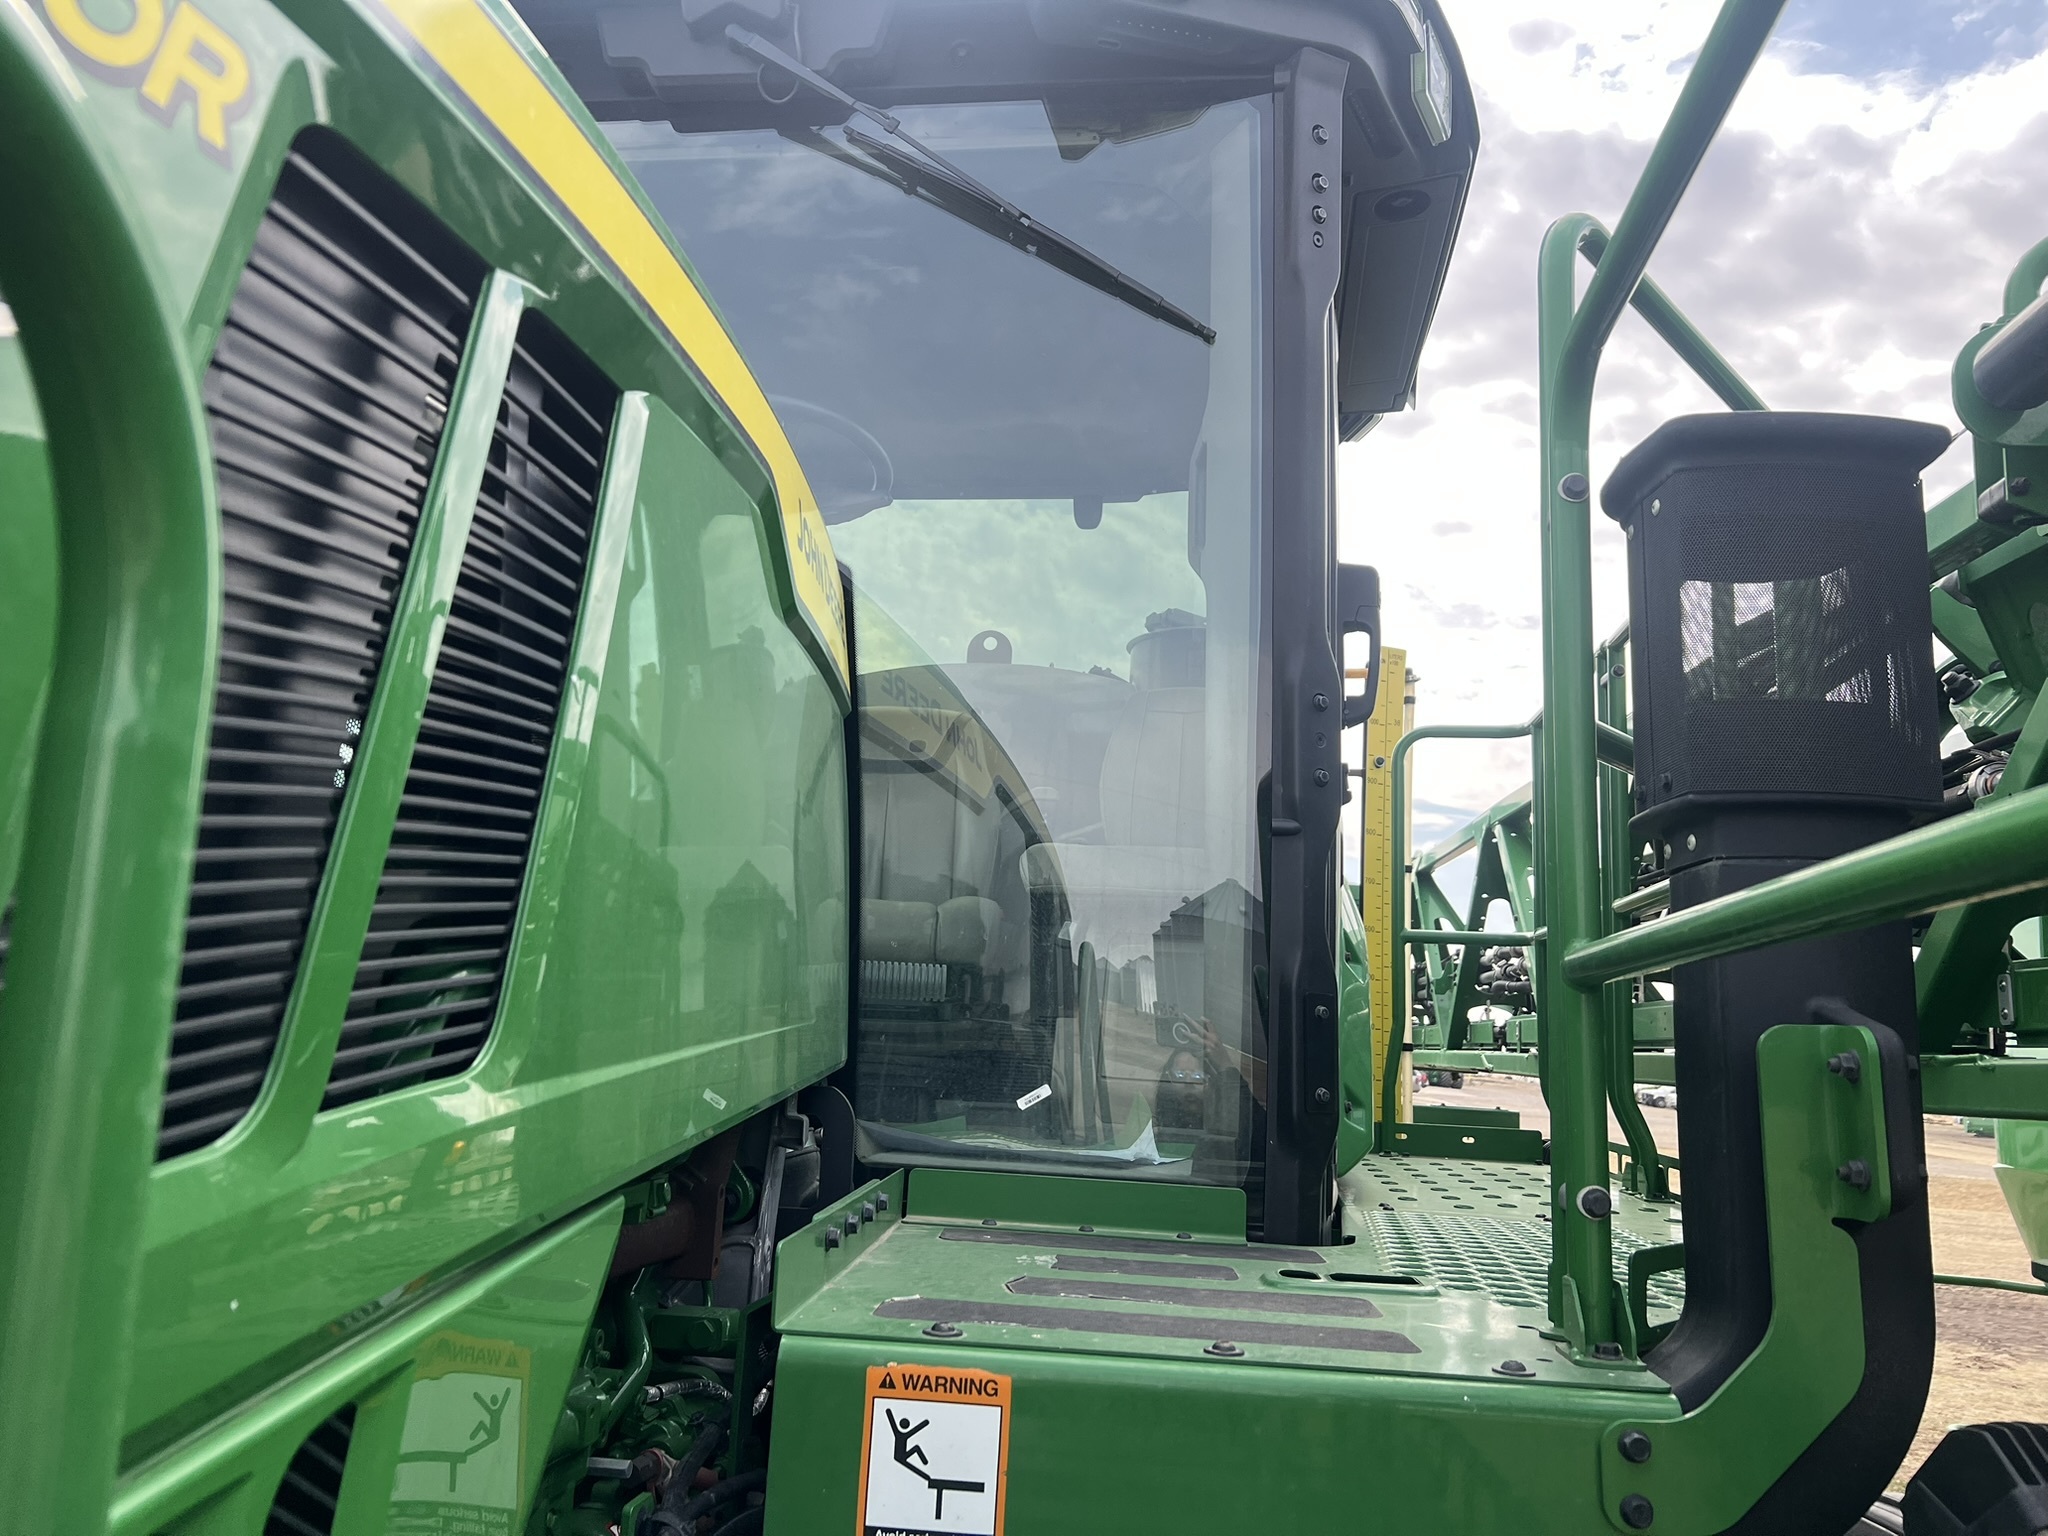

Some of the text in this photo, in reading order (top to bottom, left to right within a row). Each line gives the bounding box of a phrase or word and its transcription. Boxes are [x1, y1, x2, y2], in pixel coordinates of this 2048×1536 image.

[797, 497, 825, 593] JOHN
[1365, 876, 1376, 885] 700
[902, 1373, 999, 1398] WARNING
